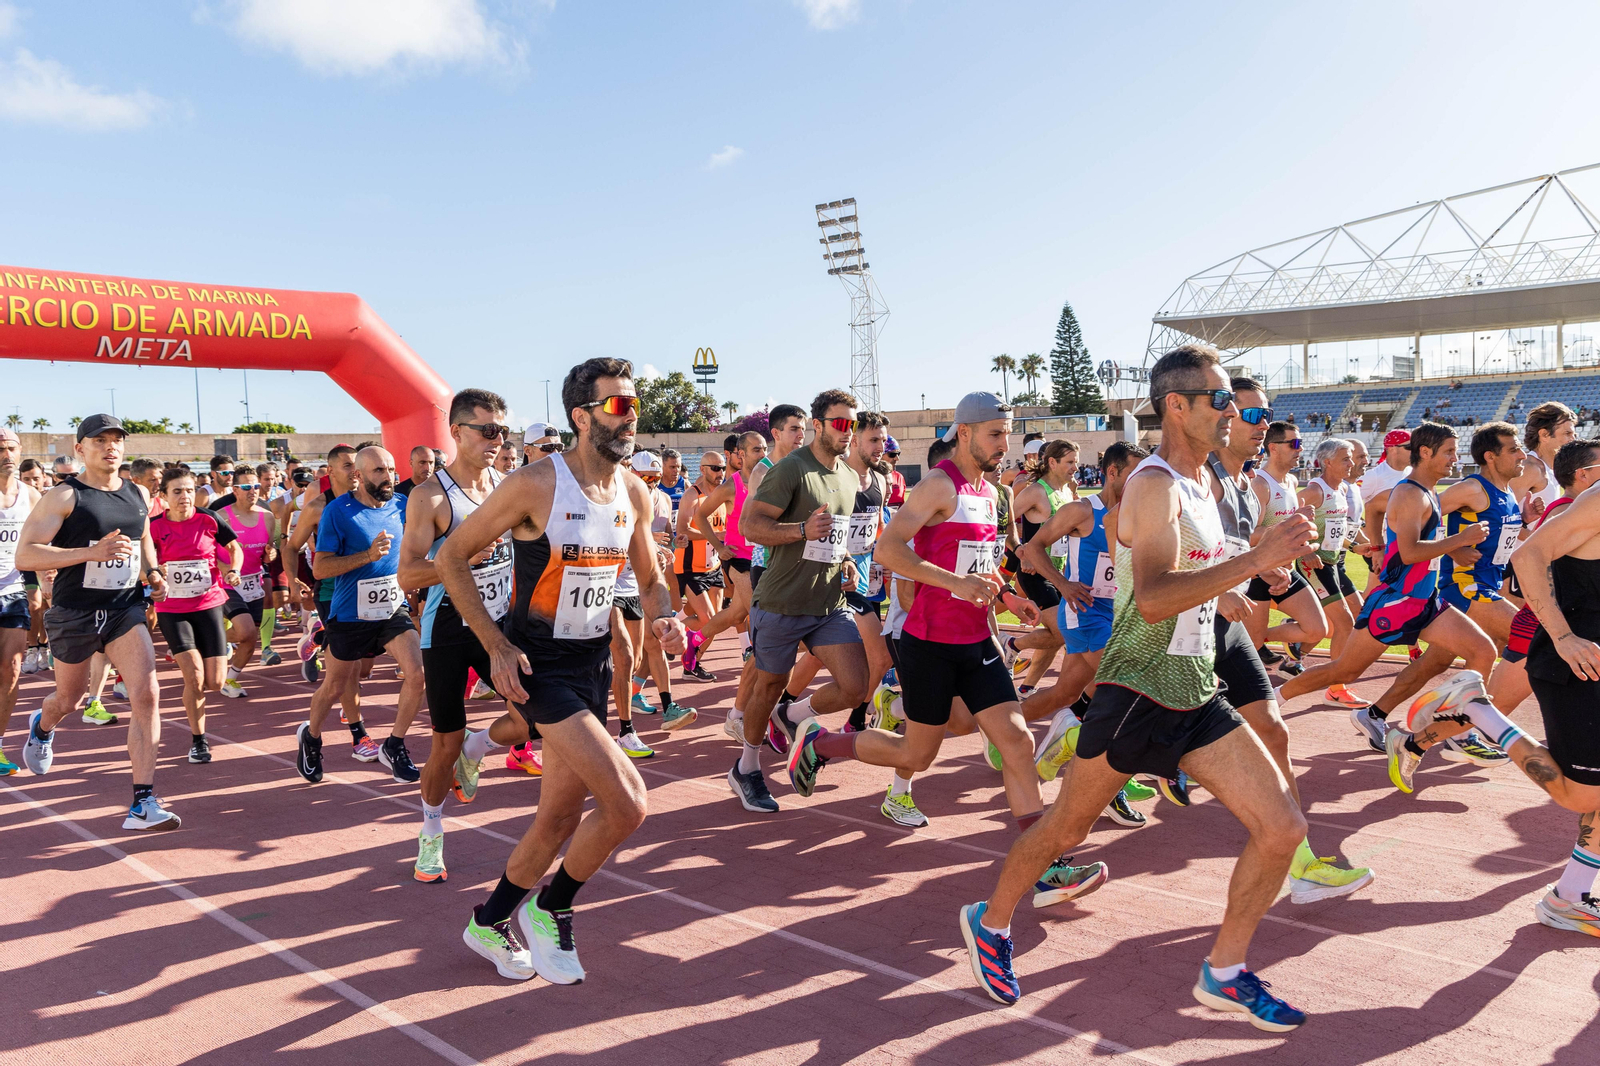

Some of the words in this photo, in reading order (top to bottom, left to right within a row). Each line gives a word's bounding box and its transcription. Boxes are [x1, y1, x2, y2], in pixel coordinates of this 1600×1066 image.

[151, 285, 183, 301] DE
[187, 287, 280, 307] MARINA
[0, 295, 99, 330] RCIO
[112, 302, 157, 333] DE
[167, 307, 312, 340] ARMADA
[96, 335, 193, 361] META
[850, 524, 873, 539] 743
[173, 570, 203, 584] 924
[242, 580, 255, 591] 45
[368, 587, 398, 604] 925
[478, 577, 504, 602] 531
[569, 585, 613, 608] 1085
